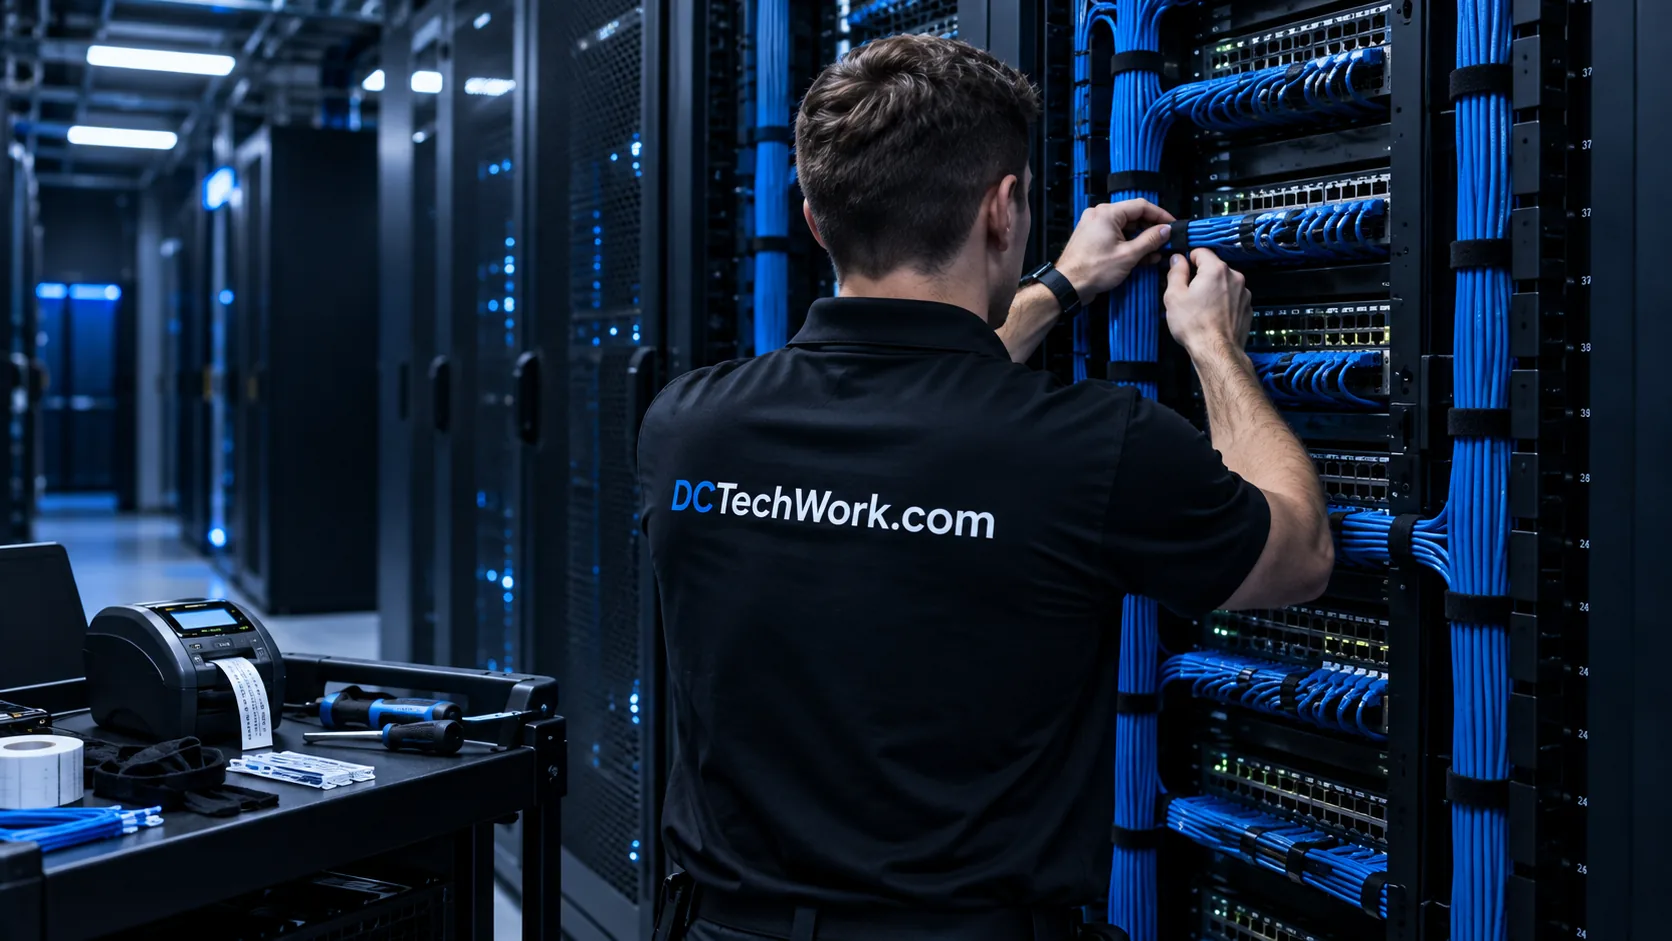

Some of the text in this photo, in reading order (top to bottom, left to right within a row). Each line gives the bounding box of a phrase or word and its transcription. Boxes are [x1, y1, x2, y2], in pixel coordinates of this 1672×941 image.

[1582, 66, 1593, 78] 37
[1582, 139, 1593, 150] 37
[671, 479, 995, 539] DCTechWork.com
